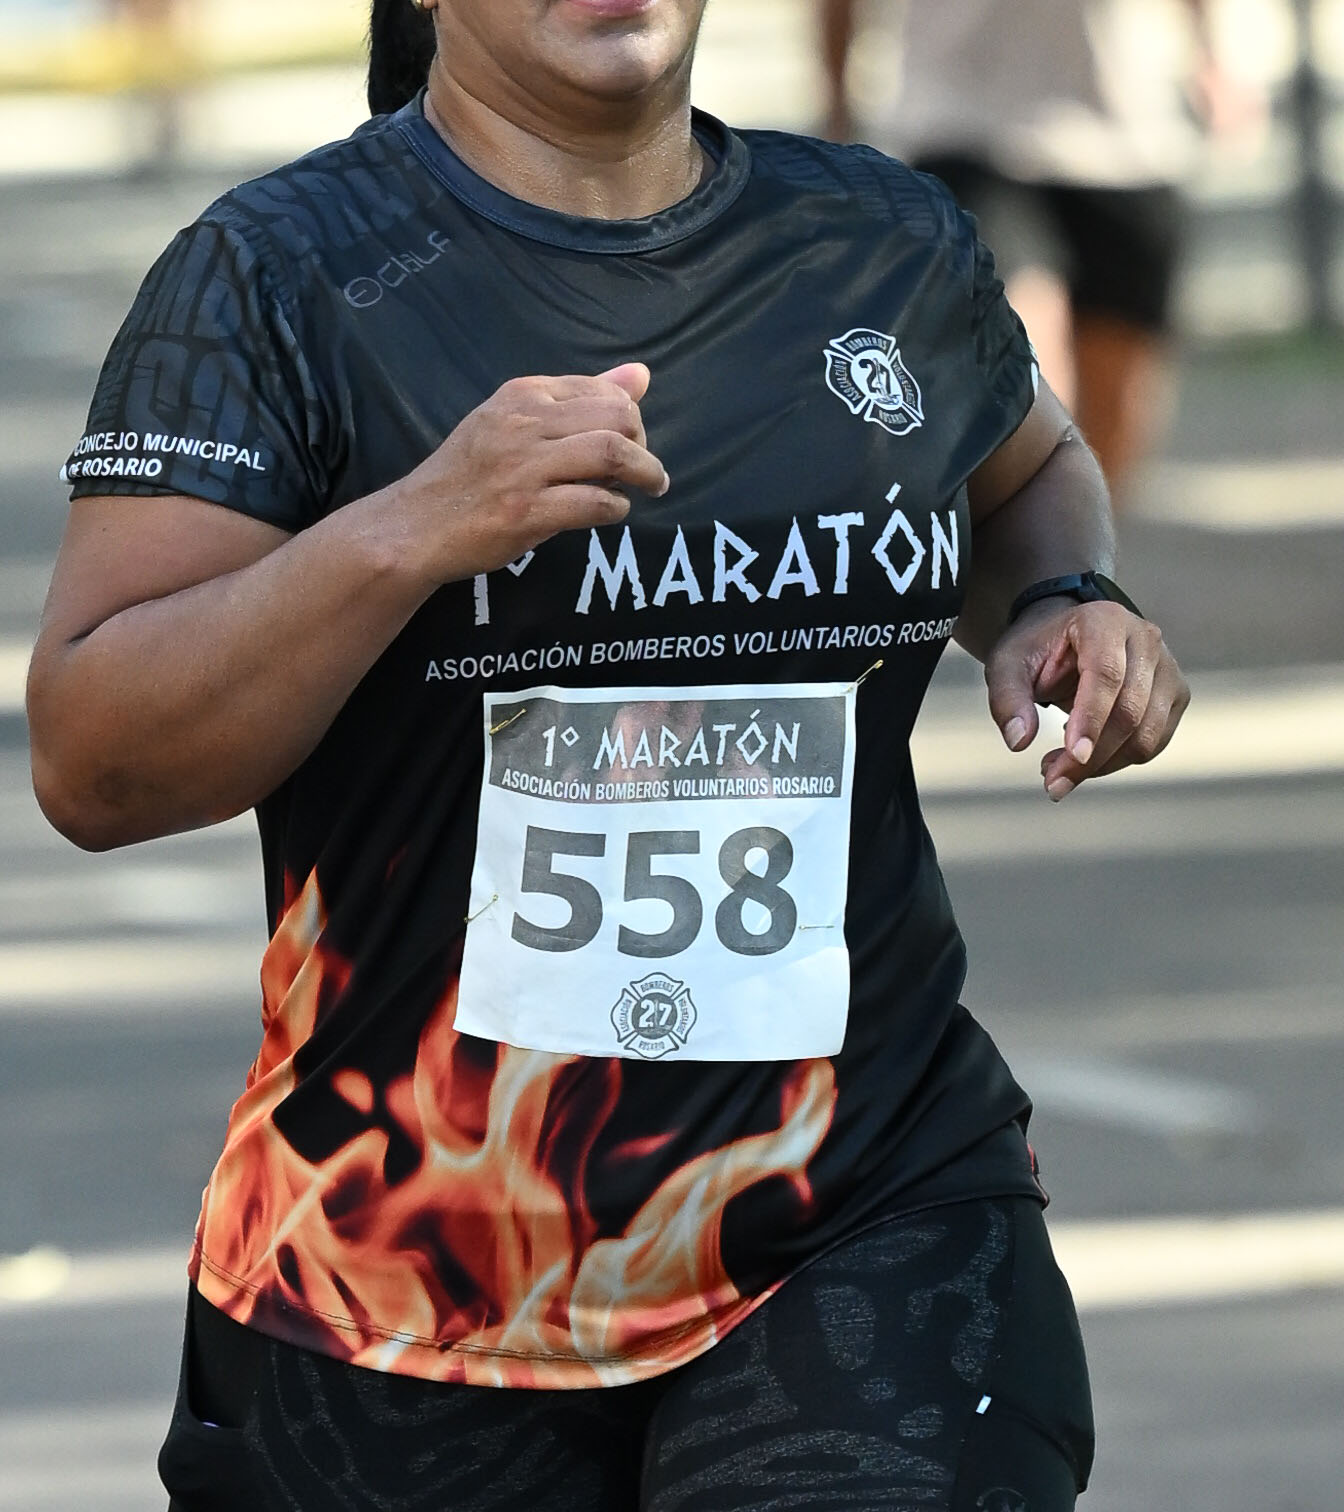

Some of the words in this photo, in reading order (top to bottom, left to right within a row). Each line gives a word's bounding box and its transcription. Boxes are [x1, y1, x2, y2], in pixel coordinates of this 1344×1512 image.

[73, 432, 139, 457] CONCEJO
[143, 433, 266, 472] MUNICIPAL
[82, 456, 163, 478] ROSARIO
[574, 481, 959, 615] MARATÓN
[425, 641, 583, 682] ASOCIACIÓN
[589, 634, 726, 665] BOMBEROS
[734, 624, 896, 656] VOLUNTARIOS
[542, 725, 581, 768] 1°
[592, 708, 801, 771] MARATÓN
[501, 768, 592, 801] ASOCIACIÓN
[595, 780, 669, 801] BOMBEROS
[673, 777, 769, 798] VOLUNTARIOS
[772, 776, 836, 796] ROSARIO
[511, 824, 798, 959] 558
[638, 998, 672, 1028] 27
